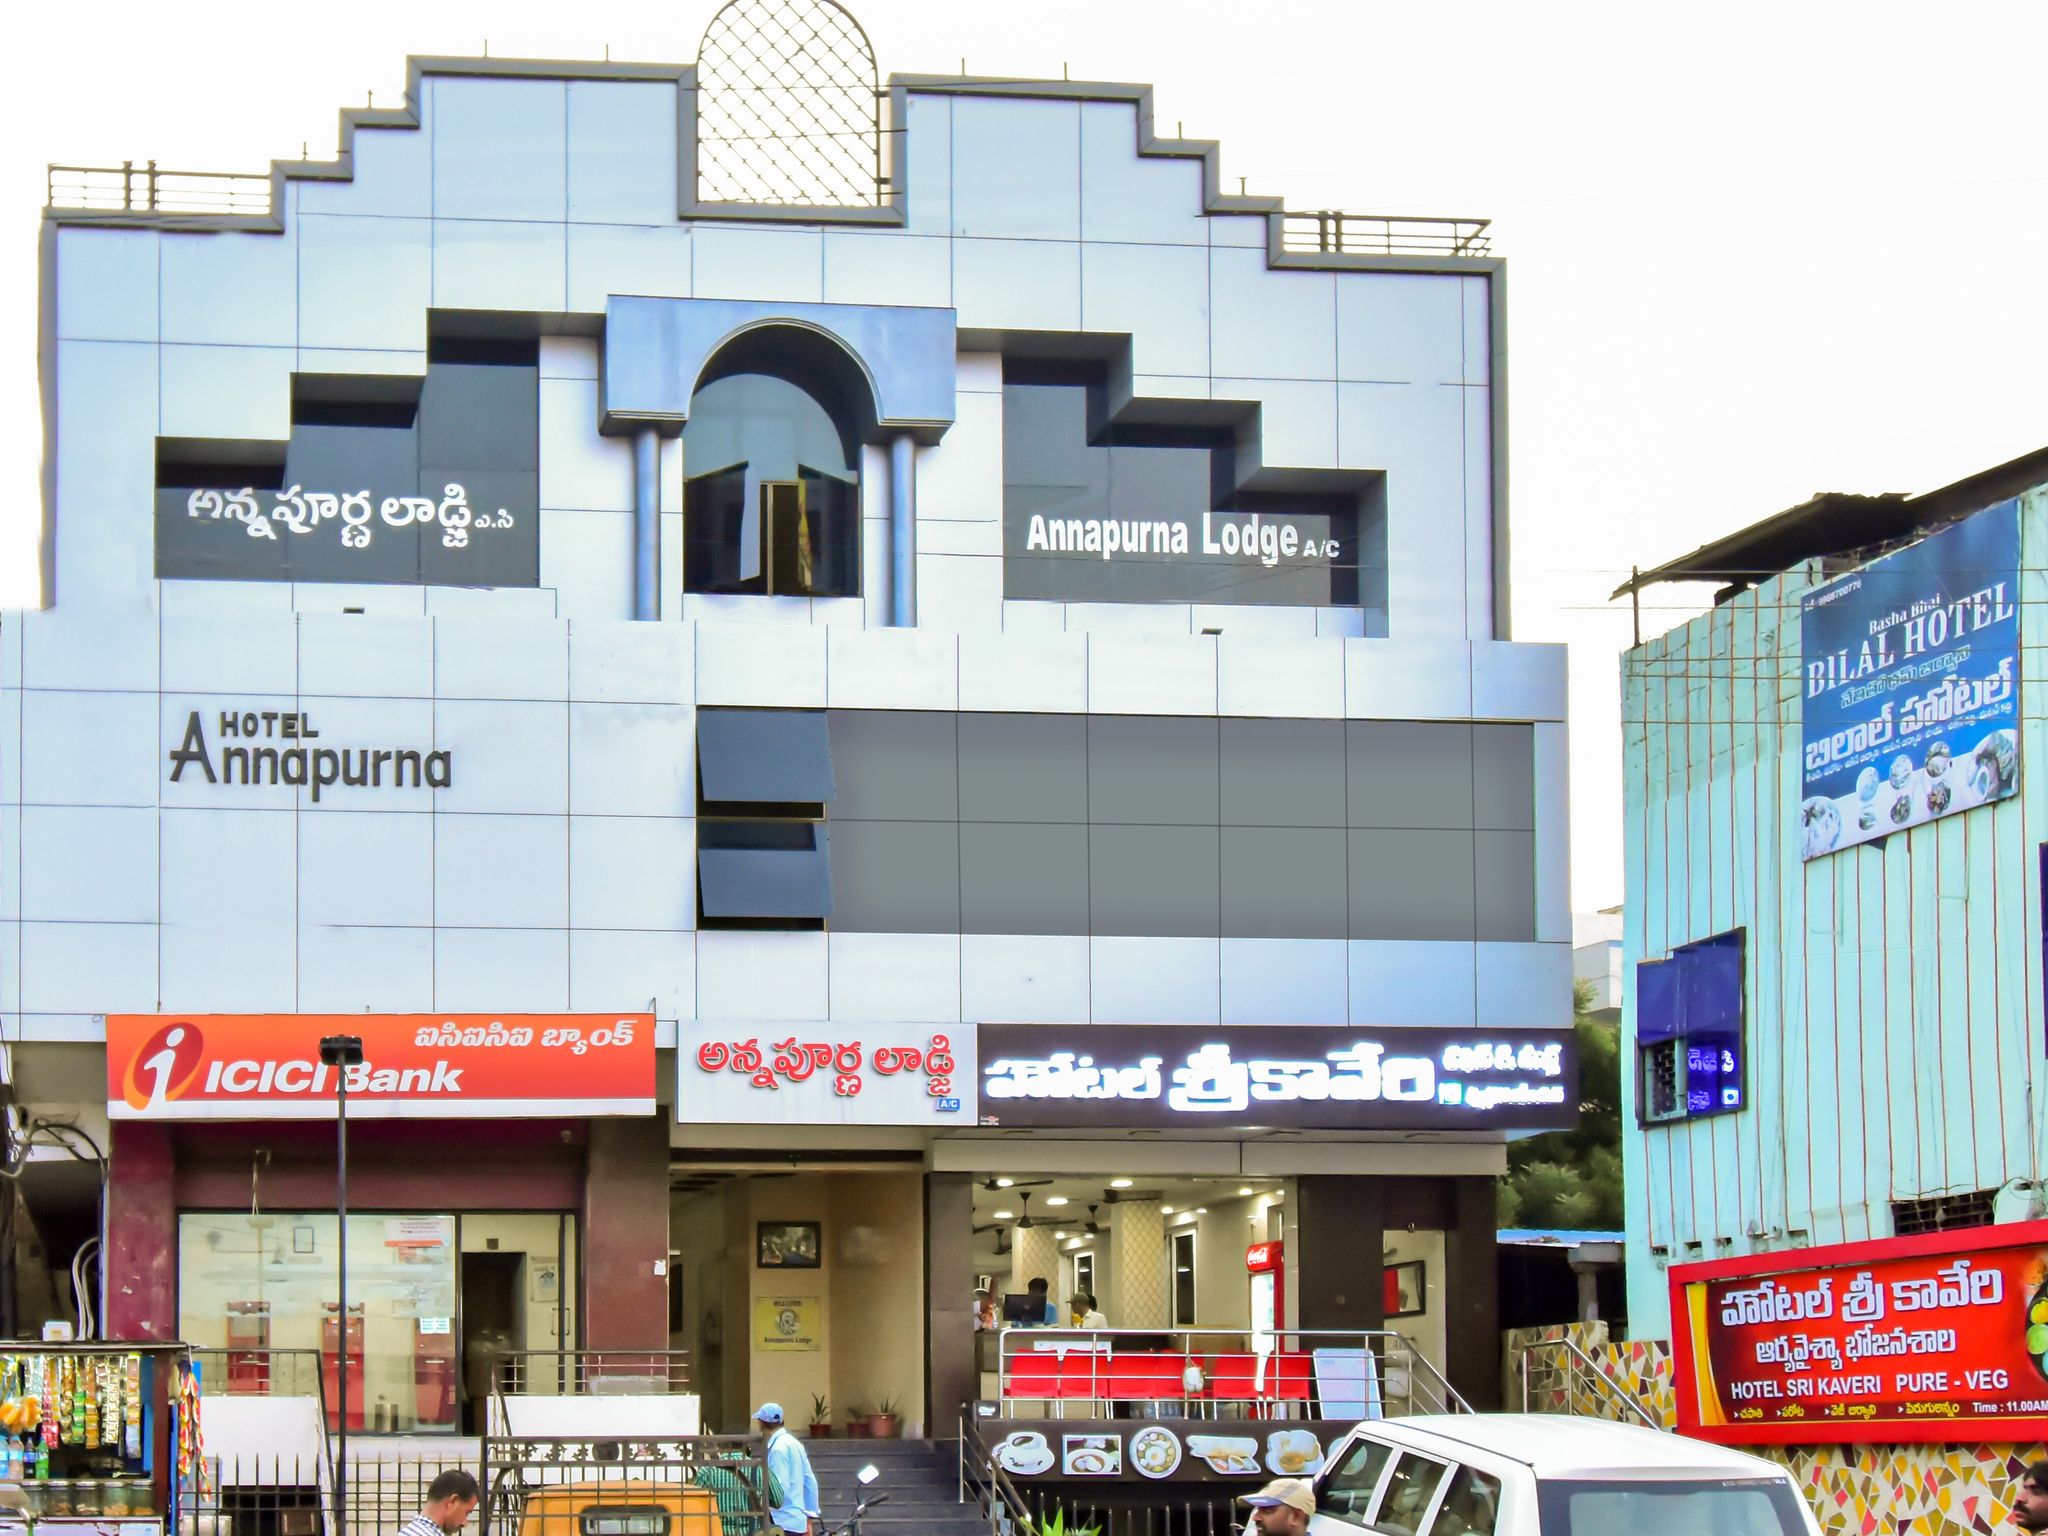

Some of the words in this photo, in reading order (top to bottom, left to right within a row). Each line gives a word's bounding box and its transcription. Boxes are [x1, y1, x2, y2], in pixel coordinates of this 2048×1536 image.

[187, 485, 372, 548] అన్నపూర్ణ
[381, 483, 472, 548] లాడ్జి
[1027, 514, 1189, 562] Annapurna
[1203, 512, 1299, 568] Lodge
[1302, 539, 1341, 558] A/C
[1807, 630, 1895, 699] BILAL
[1903, 581, 2014, 660] HOTEL
[1869, 609, 1908, 635] Basha
[219, 711, 320, 739] HOTEL
[1804, 701, 1895, 771] బిలాల్
[1899, 656, 2014, 734] హోటల్
[169, 711, 452, 803] Annapurna
[414, 1022, 532, 1048] ఐసిఐసిఐ
[541, 1020, 638, 1056] బ్యాంక్
[204, 1061, 327, 1093] ICICI
[338, 1061, 464, 1093] Bank
[696, 1036, 863, 1097] అన్నపూర్ణ
[872, 1033, 956, 1097] లాడ్జి
[939, 1098, 959, 1110] A/C
[1720, 1278, 1834, 1327] హోటల్
[1842, 1271, 1885, 1323] శ్రీ
[1891, 1259, 2003, 1312] కావేరి
[1845, 1323, 1957, 1364] భోజనశాల
[1731, 1380, 1783, 1400] HOTEL
[1786, 1378, 1814, 1398] SRI
[1817, 1375, 1881, 1396] KAVERI
[1895, 1372, 1949, 1393] PURE
[1964, 1369, 2010, 1391] VEG
[1973, 1402, 1997, 1413] Time
